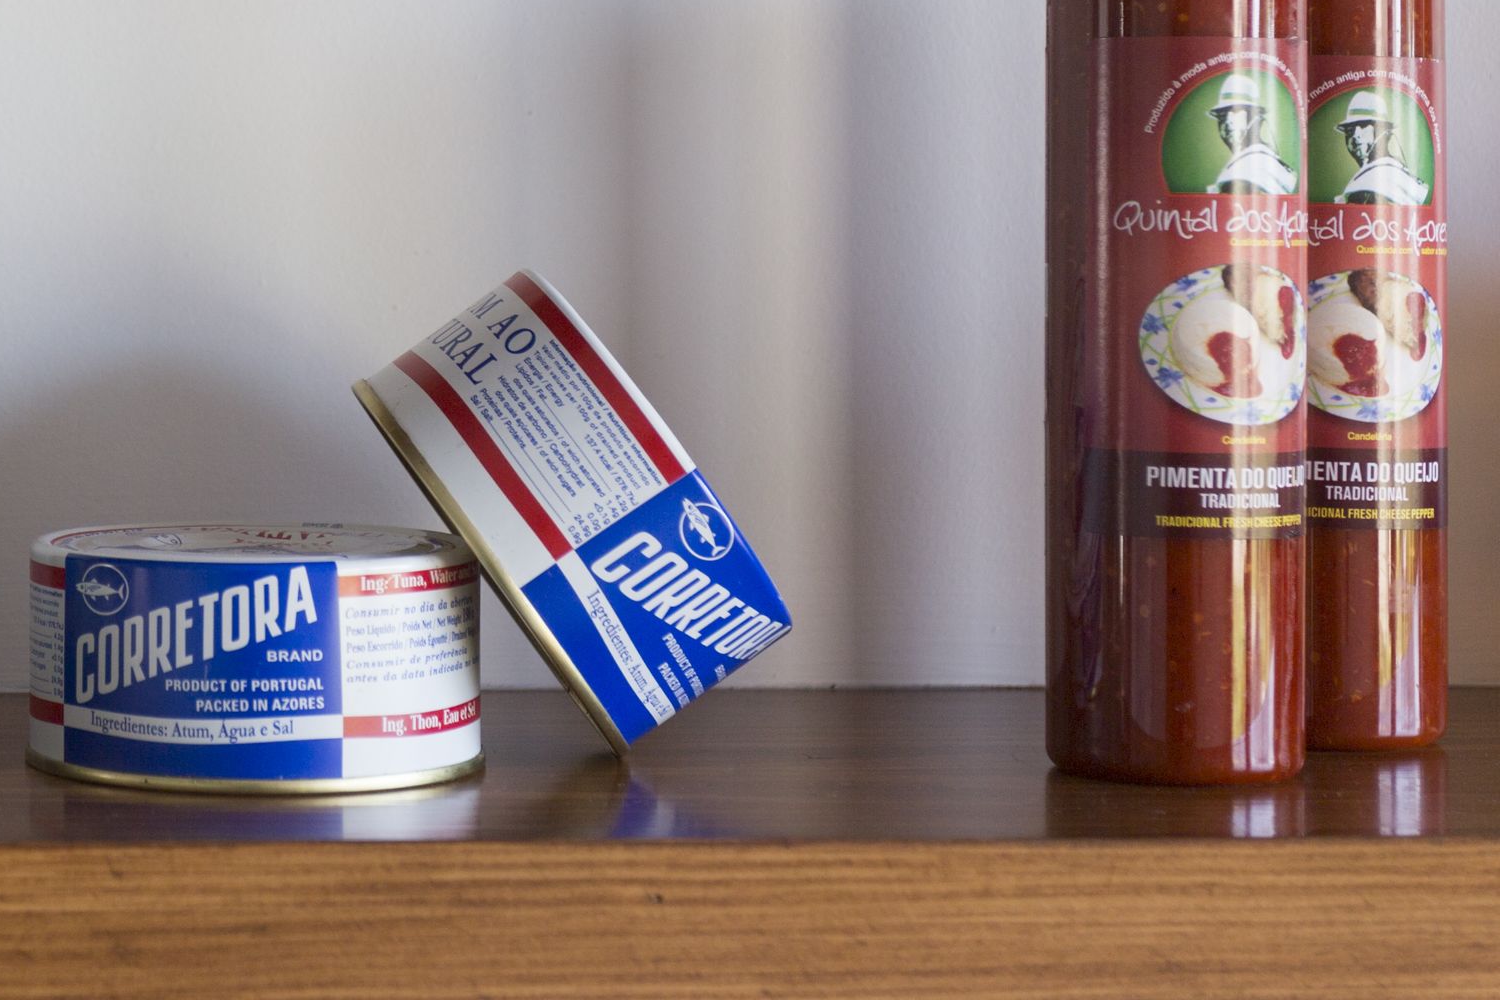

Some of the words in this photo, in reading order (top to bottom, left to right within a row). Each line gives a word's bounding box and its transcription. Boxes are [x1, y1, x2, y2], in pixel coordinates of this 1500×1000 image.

[1144, 88, 1176, 134] Produzido
[1180, 62, 1207, 83] moda
[1207, 52, 1238, 66] antiga
[1310, 79, 1334, 99] moda
[1336, 70, 1366, 84] antiga
[1367, 69, 1387, 78] com
[1113, 200, 1217, 239] Quintal
[1225, 203, 1271, 232] dos
[1352, 213, 1400, 242] dos
[487, 314, 536, 354] AO
[544, 383, 564, 407] Energy
[525, 411, 547, 438] carbono
[576, 371, 604, 407] nutricional
[607, 412, 631, 442] Nutrition
[631, 444, 662, 485] information
[579, 393, 593, 409] 100g
[600, 421, 623, 449] produto
[504, 420, 526, 448] Proteins
[576, 405, 590, 421] 100g
[596, 431, 618, 459] drained
[617, 460, 640, 489] product
[556, 474, 575, 497] sugars
[579, 464, 604, 497] saturated
[1145, 465, 1237, 489] PIMENTA
[1241, 467, 1264, 489] DO
[1366, 462, 1390, 482] DO
[1394, 461, 1439, 485] QUEIJO
[1200, 493, 1281, 509] TRADICIONAL
[1325, 485, 1409, 501] TRADICIONAL
[1155, 515, 1222, 528] TRADICIONAL
[1223, 517, 1253, 529] FRESH
[1348, 508, 1378, 519] FRESH
[1379, 508, 1410, 519] CHEESE
[1411, 508, 1435, 519] PEPPER
[390, 573, 427, 589] Tuna,
[420, 601, 434, 612] dia
[75, 565, 318, 704] CORRETORA
[266, 650, 323, 663] BRAND
[662, 632, 693, 671] PRODUCT
[402, 670, 425, 680] data
[429, 661, 463, 675] indicada
[658, 661, 681, 692] PACKED
[165, 679, 226, 693] PRODUCT
[230, 679, 248, 692] OF
[251, 678, 324, 692] PORTUGAL
[196, 699, 250, 713] PACKED
[253, 699, 268, 712] IN
[272, 696, 325, 711] AZORES
[91, 710, 168, 737] Ingredientes:
[172, 721, 215, 742] Atum,
[218, 718, 256, 744] Água
[260, 727, 268, 737] e
[272, 721, 294, 736] Sal
[382, 716, 407, 736] Ing.
[410, 713, 441, 731] Thon,
